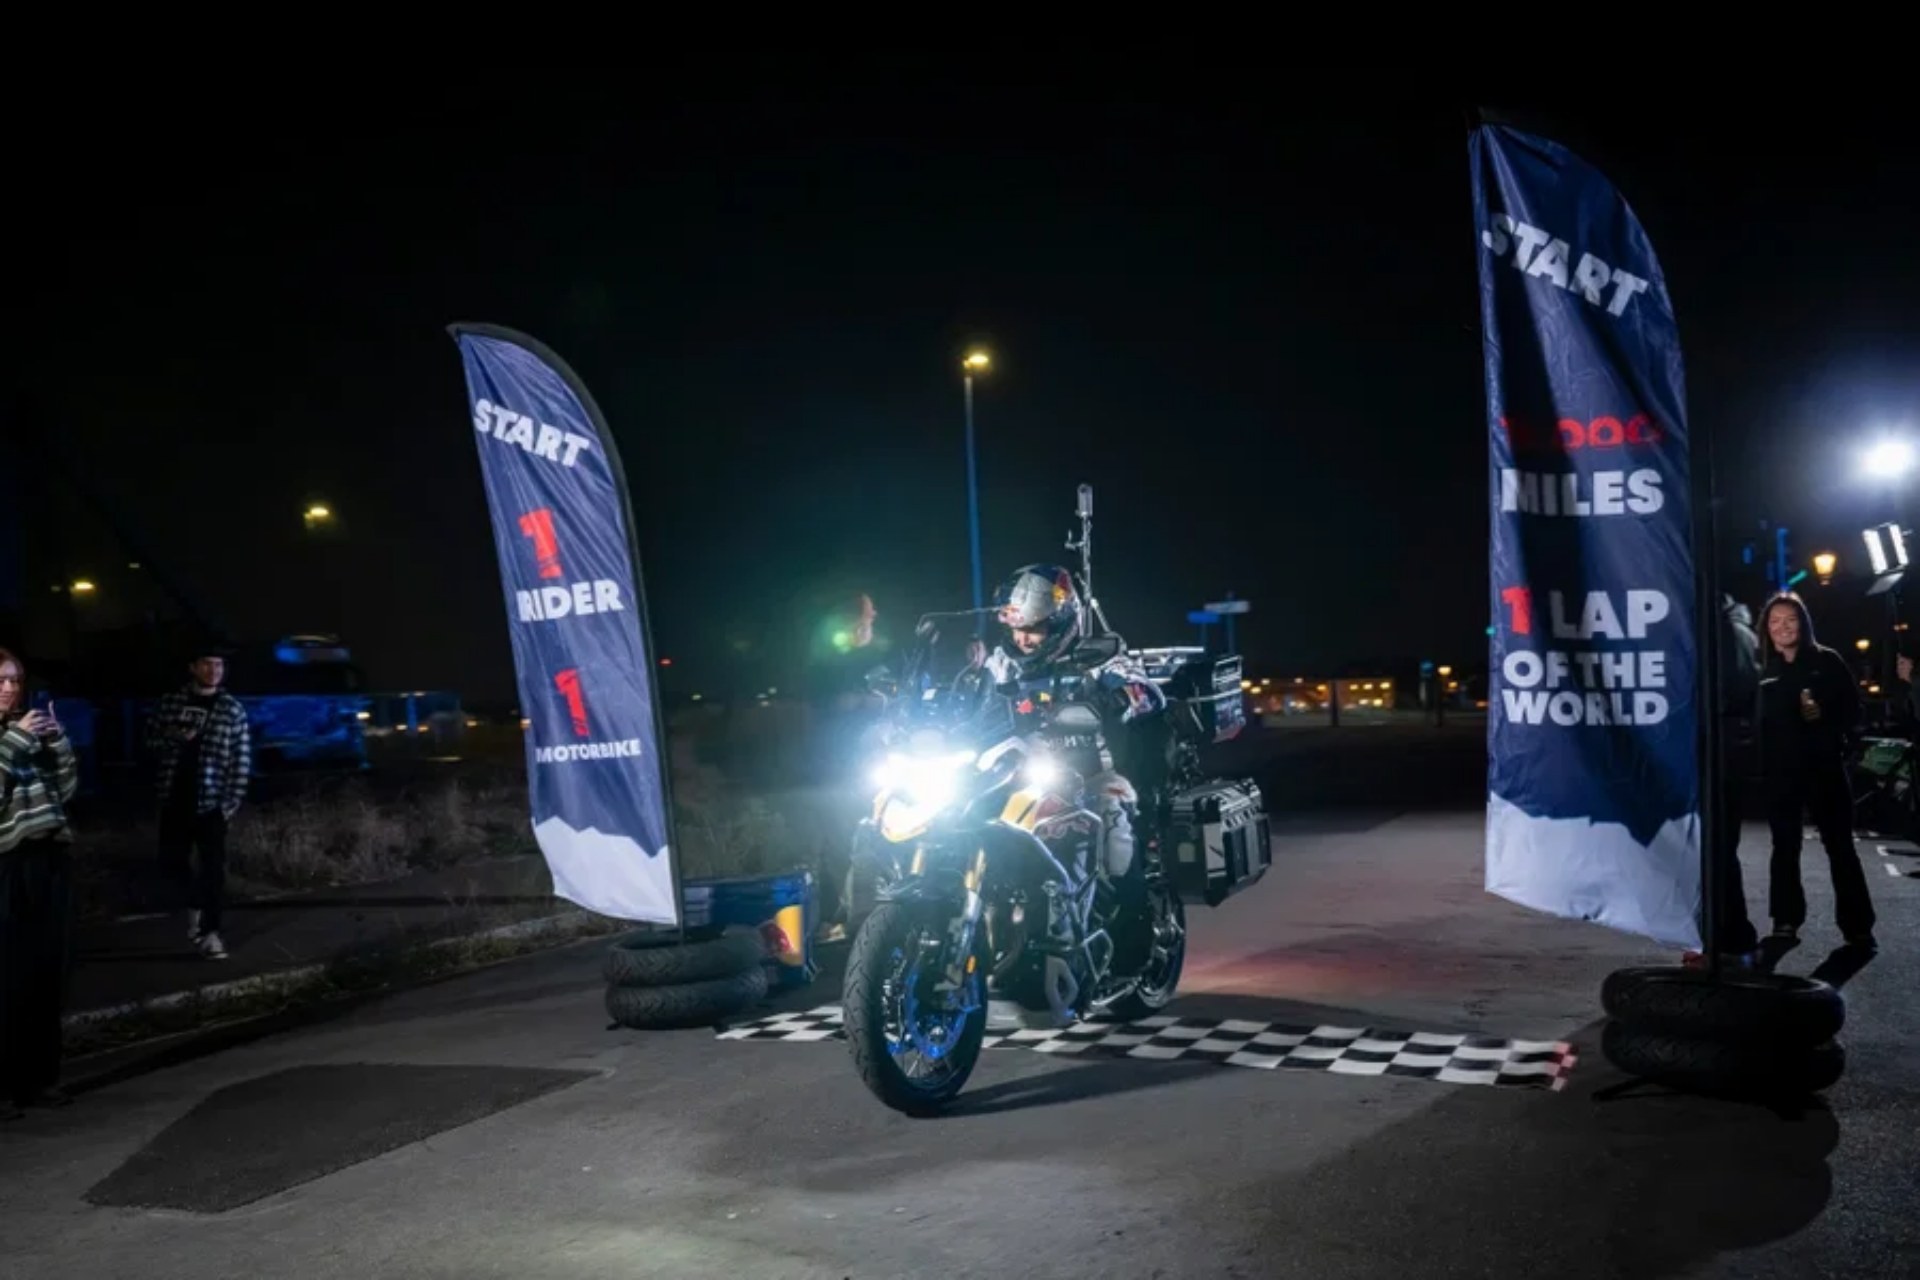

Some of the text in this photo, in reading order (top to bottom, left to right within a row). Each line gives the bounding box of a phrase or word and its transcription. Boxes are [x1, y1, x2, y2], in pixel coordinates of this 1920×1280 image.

[1482, 212, 1649, 318] START
[473, 398, 590, 468] START
[1501, 468, 1665, 516] MILES
[519, 507, 563, 579] 1
[516, 579, 624, 622] RIDER
[1501, 586, 1670, 640] 1 LAP
[1503, 650, 1667, 689] OF THE
[555, 668, 591, 737] 1
[1501, 689, 1669, 726] WORLD
[535, 738, 642, 763] MOTORBIKE
